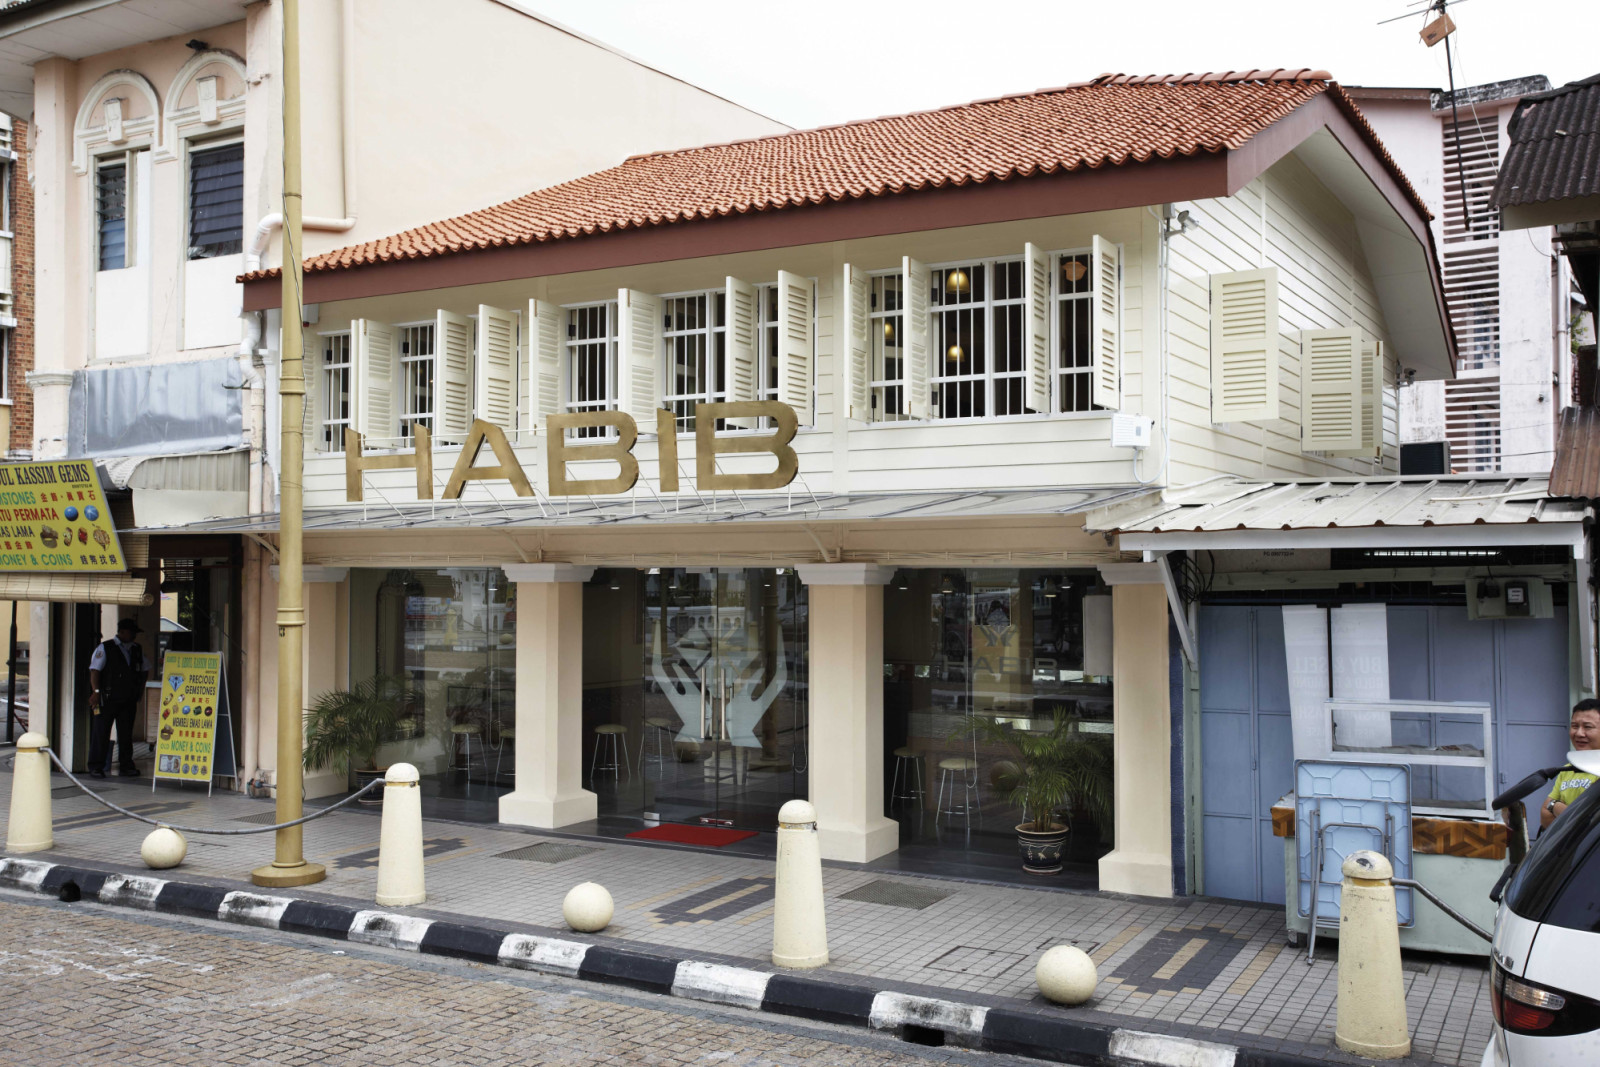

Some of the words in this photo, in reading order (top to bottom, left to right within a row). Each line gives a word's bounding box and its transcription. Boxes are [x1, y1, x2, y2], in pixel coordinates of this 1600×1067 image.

[345, 399, 799, 502] HABIB
[14, 465, 58, 485] KASSIM
[58, 463, 90, 483] GEMS
[13, 507, 59, 521] PERMATA
[11, 525, 36, 538] LAMA
[30, 554, 38, 566] &
[41, 554, 73, 566] COINS
[943, 655, 1058, 676] HABIB
[189, 674, 215, 686] PRECIOUS
[184, 685, 216, 696] GEMSTONES
[170, 740, 189, 752] MONEY
[195, 741, 211, 754] COINS
